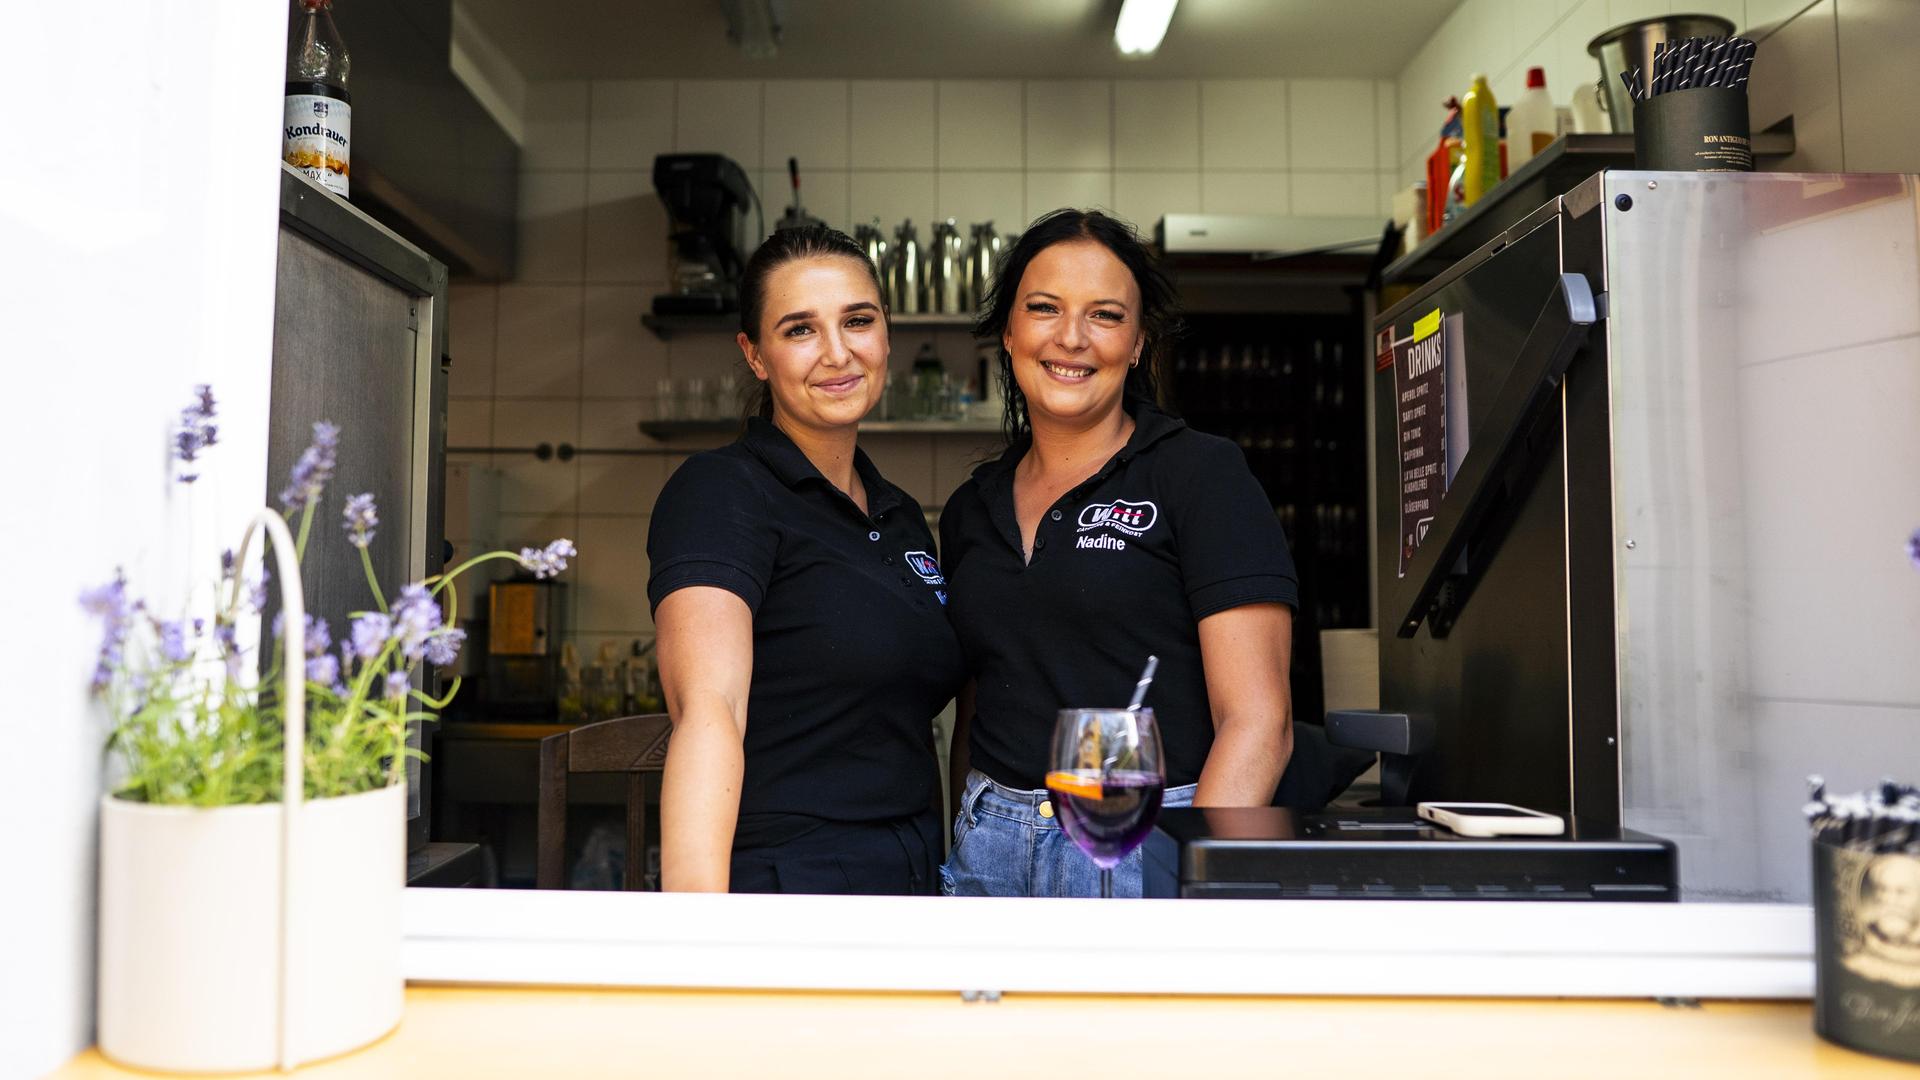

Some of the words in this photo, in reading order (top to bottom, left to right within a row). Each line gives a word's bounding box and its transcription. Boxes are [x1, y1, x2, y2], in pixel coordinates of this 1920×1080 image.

[286, 122, 347, 147] Kondrauer
[1408, 332, 1441, 380] DRINKS
[1402, 389, 1416, 403] APEROL
[1091, 505, 1144, 526] Witt
[1076, 533, 1126, 551] Nadine
